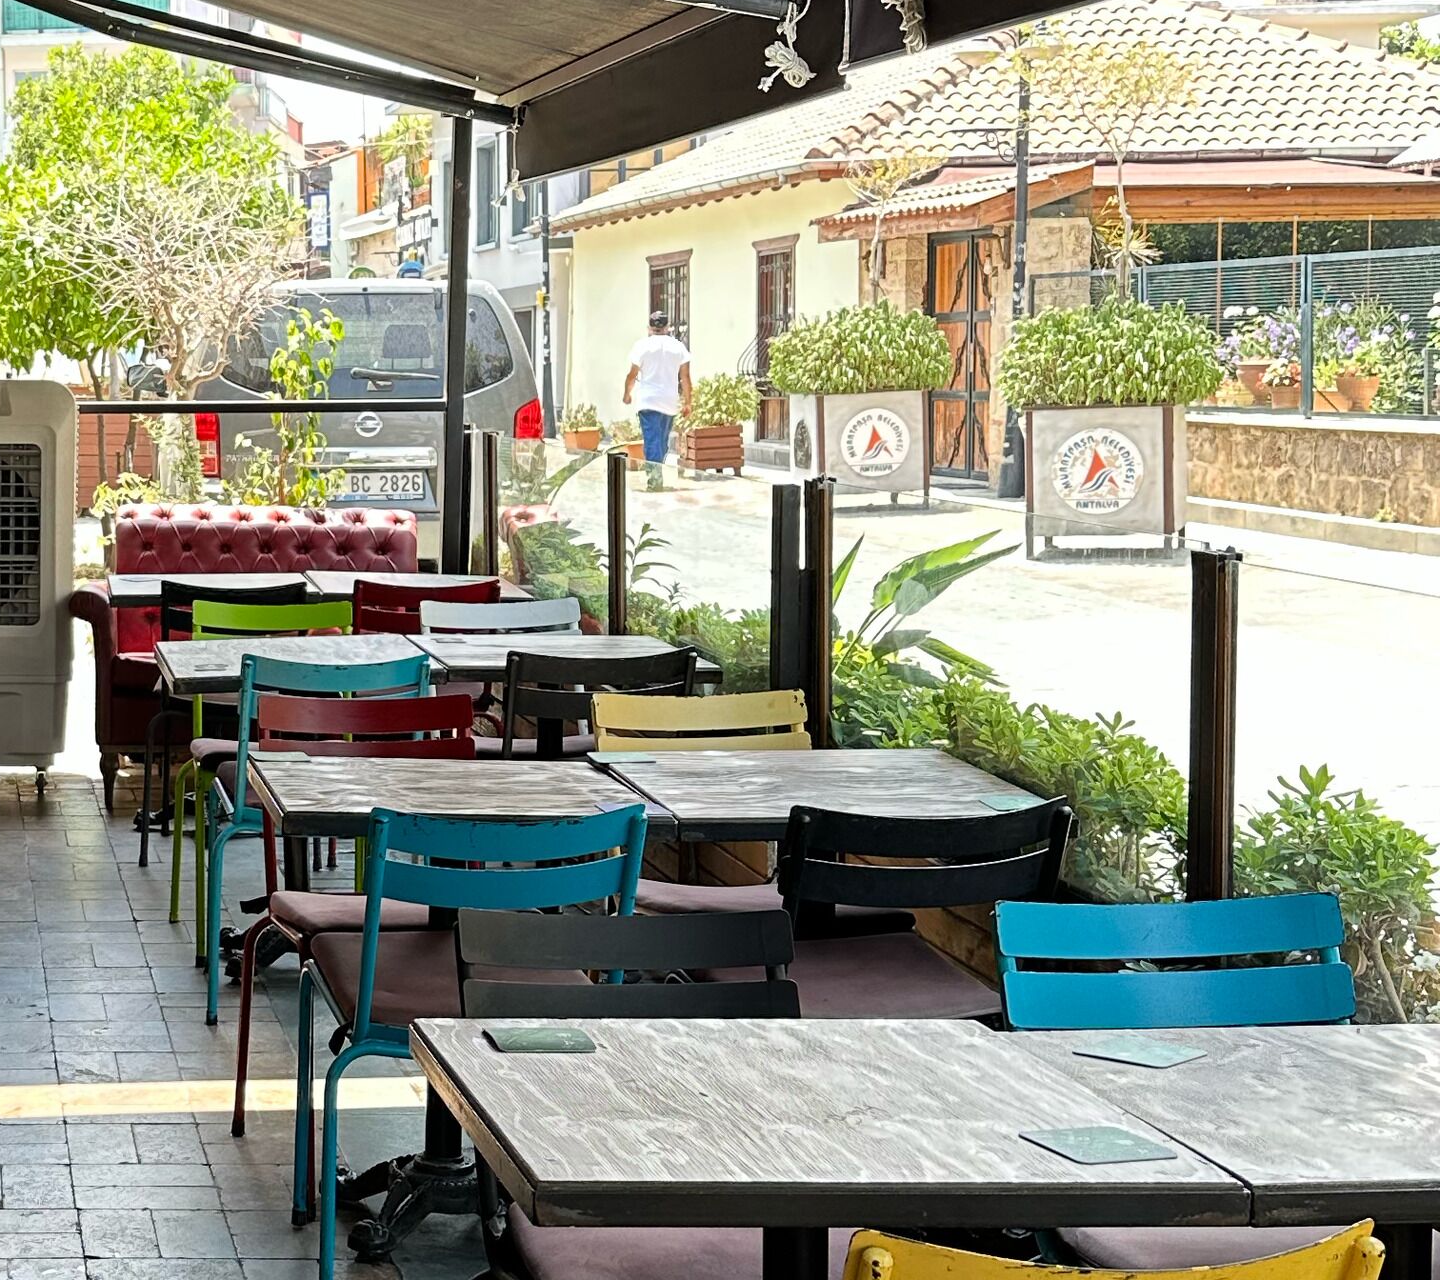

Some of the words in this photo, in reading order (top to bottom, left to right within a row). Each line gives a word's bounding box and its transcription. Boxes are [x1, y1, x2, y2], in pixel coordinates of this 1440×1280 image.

[350, 475, 371, 493] BC
[379, 474, 421, 493] 2826
[1076, 500, 1119, 509] ANTALYA
